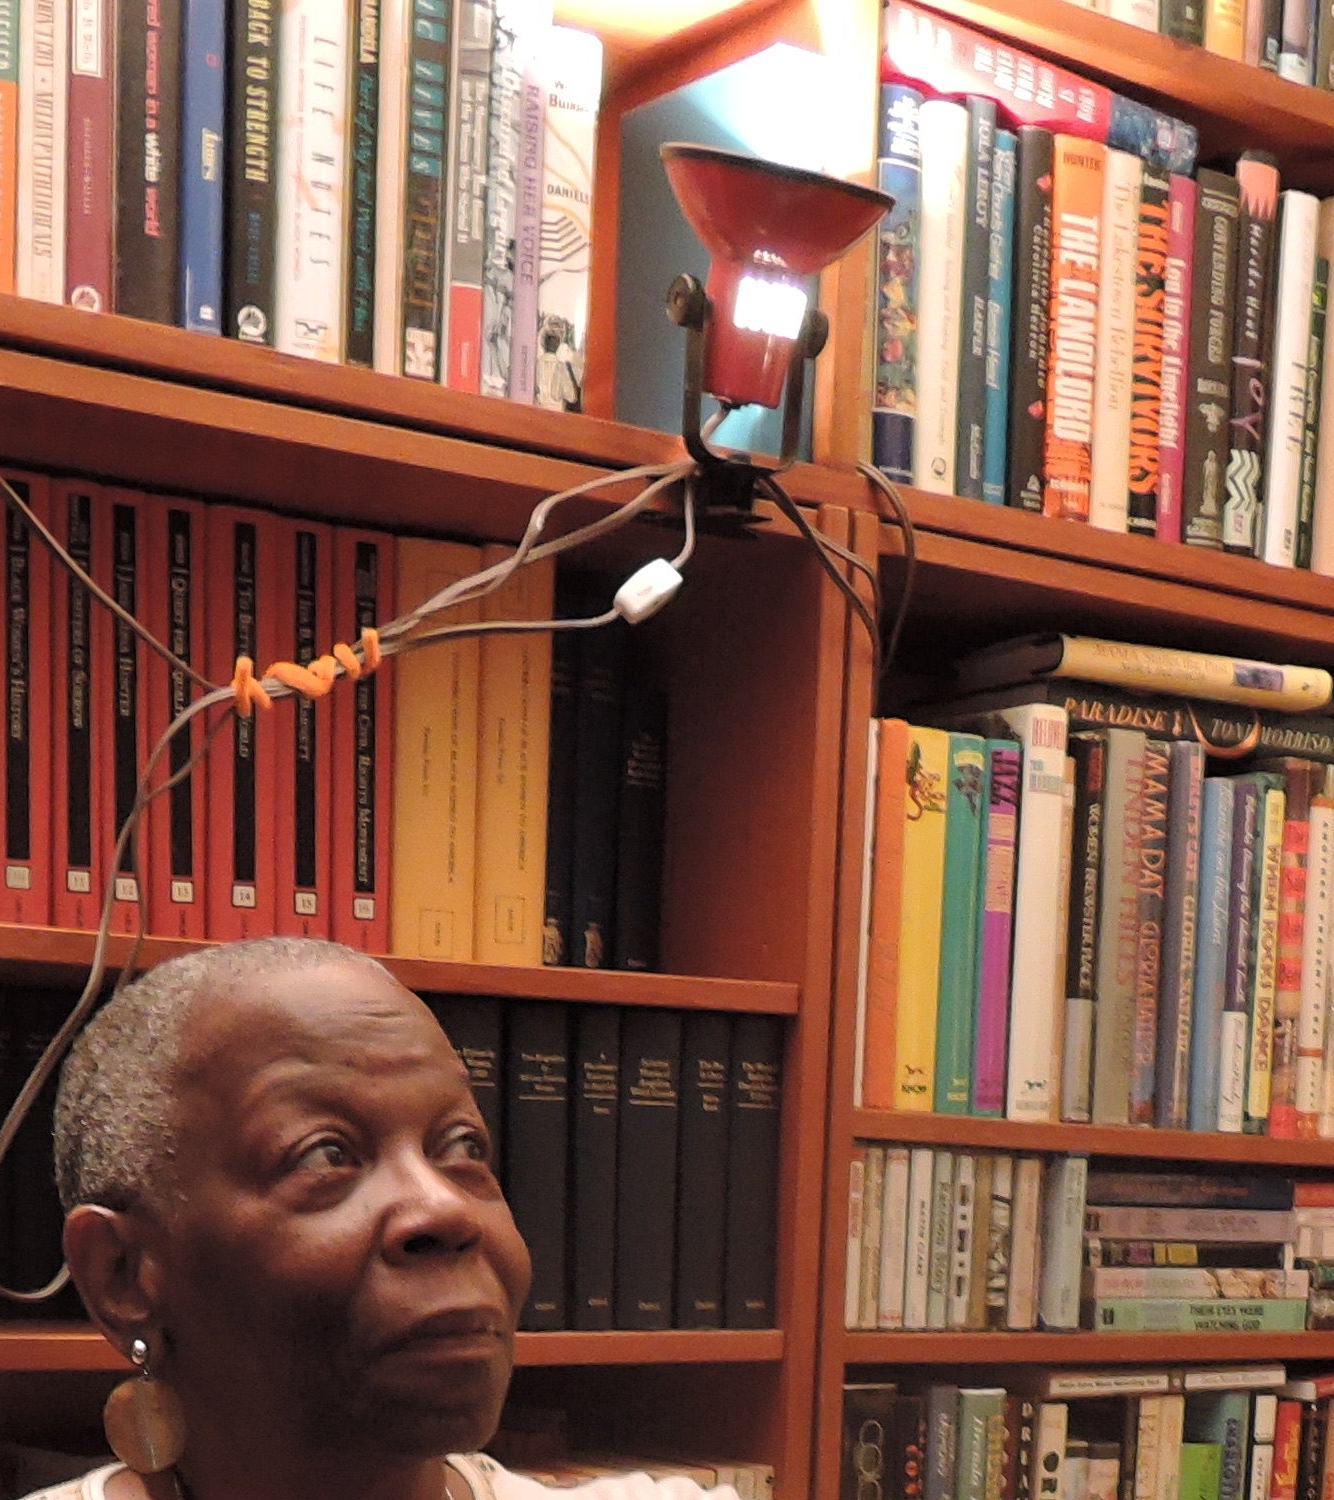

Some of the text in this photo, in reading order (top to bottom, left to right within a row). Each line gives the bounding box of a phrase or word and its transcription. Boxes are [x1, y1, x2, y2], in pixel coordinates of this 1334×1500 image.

[244, 57, 269, 183] TO STRENGTH
[520, 84, 541, 285] RAISING HER VOICE
[1053, 212, 1099, 444] THE LANDLORD
[1128, 199, 1167, 496] THE SURVIVORS
[1065, 696, 1169, 734] PARADISE
[1138, 751, 1168, 899] MAMA DAY
